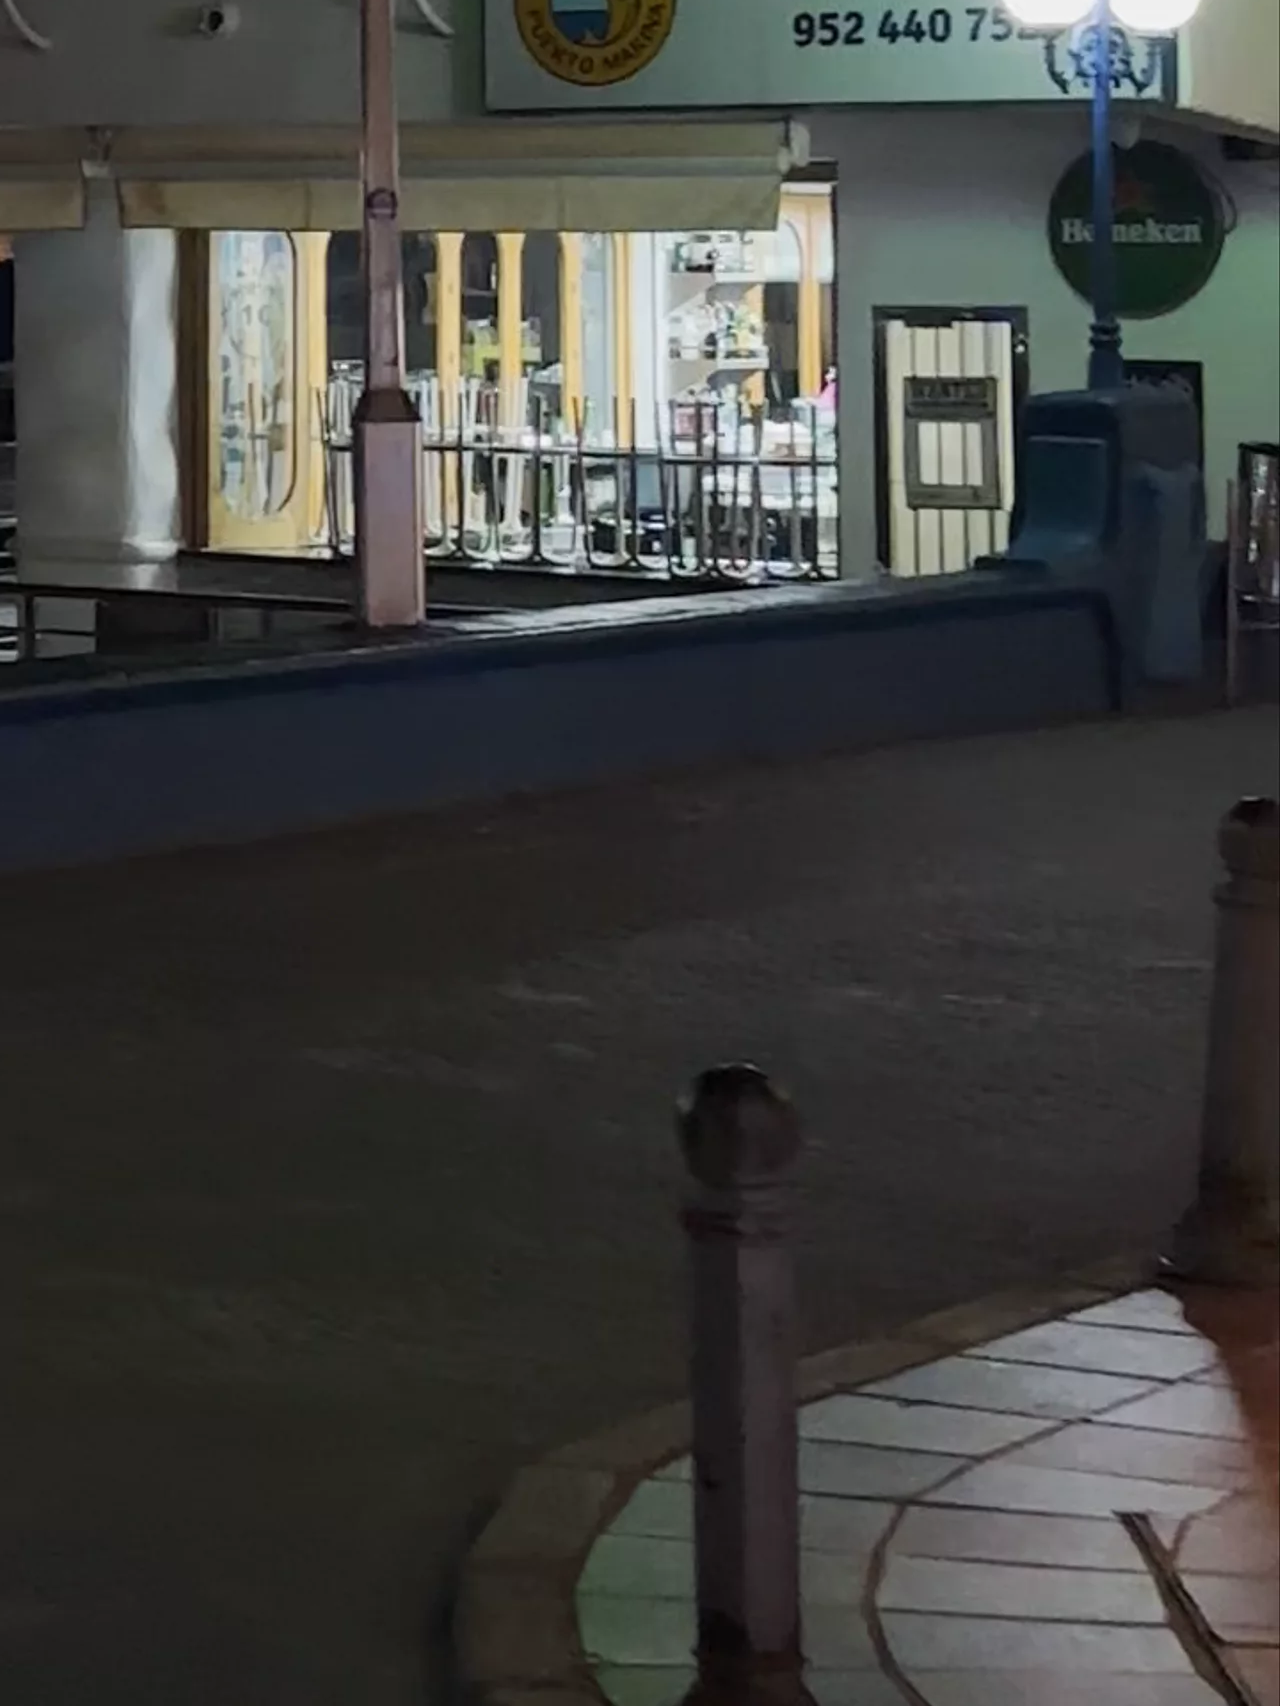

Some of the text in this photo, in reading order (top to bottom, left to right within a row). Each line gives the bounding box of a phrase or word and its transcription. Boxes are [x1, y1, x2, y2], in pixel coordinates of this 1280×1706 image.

[527, 2, 667, 75] PUERTO MARINA
[792, 12, 865, 47] 952
[877, 8, 952, 43] 440
[1061, 218, 1203, 243] Heneken
